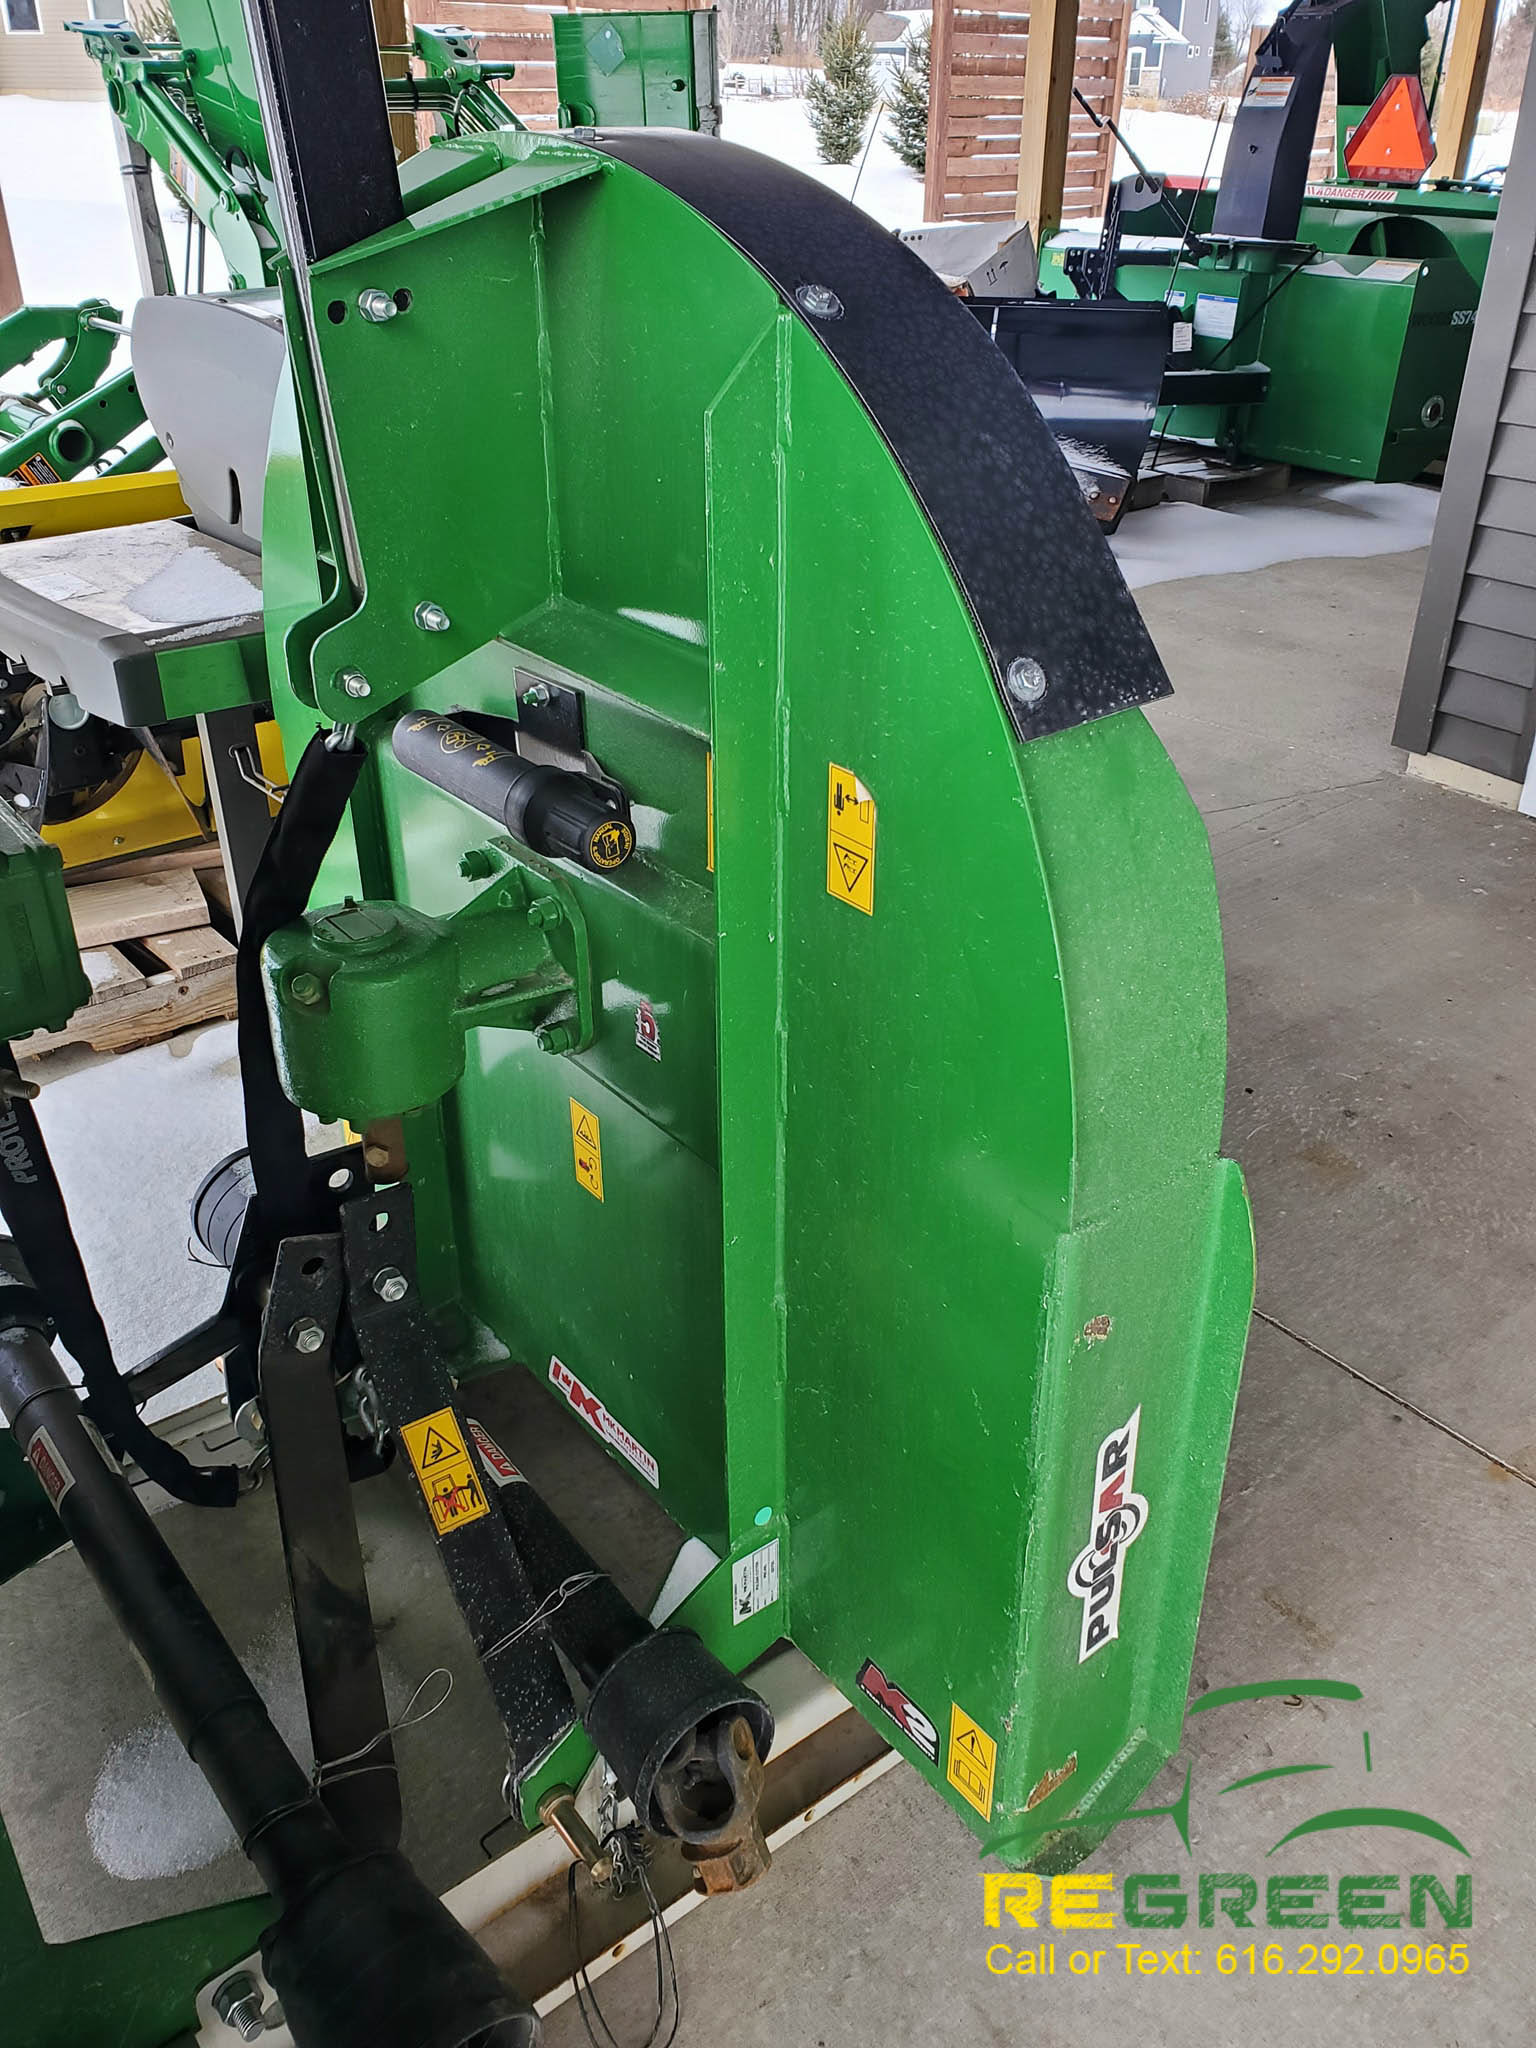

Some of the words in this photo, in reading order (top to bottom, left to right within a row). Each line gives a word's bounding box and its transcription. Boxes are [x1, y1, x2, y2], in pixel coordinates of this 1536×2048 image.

[1323, 187, 1366, 199] DANGER
[469, 1426, 505, 1461] DANGER
[616, 1427, 656, 1472] MARTIN
[1085, 1429, 1131, 1653] PULSAR
